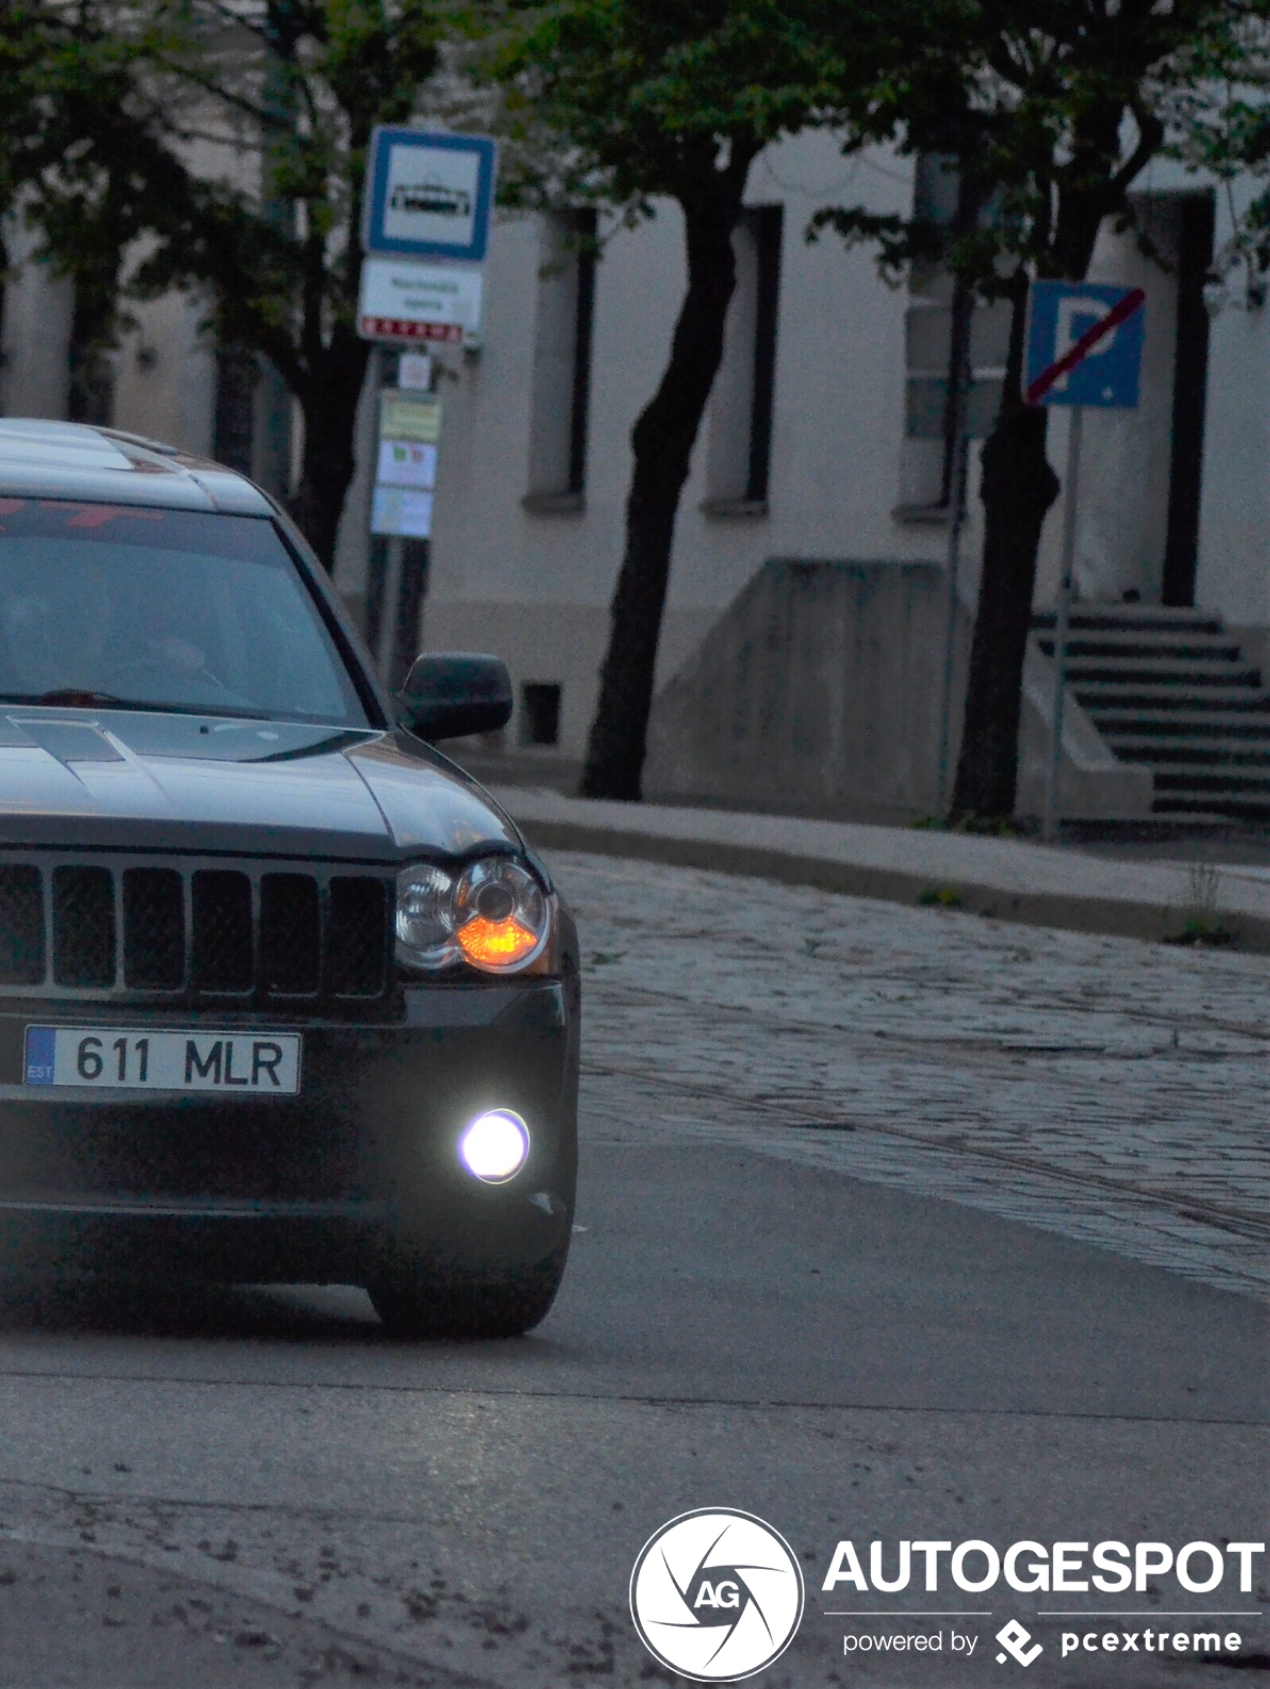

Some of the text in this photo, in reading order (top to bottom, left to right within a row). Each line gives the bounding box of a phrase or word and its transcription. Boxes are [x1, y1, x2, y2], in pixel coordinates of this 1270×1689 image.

[27, 1064, 53, 1079] EST
[76, 1036, 284, 1086] 611 MLR
